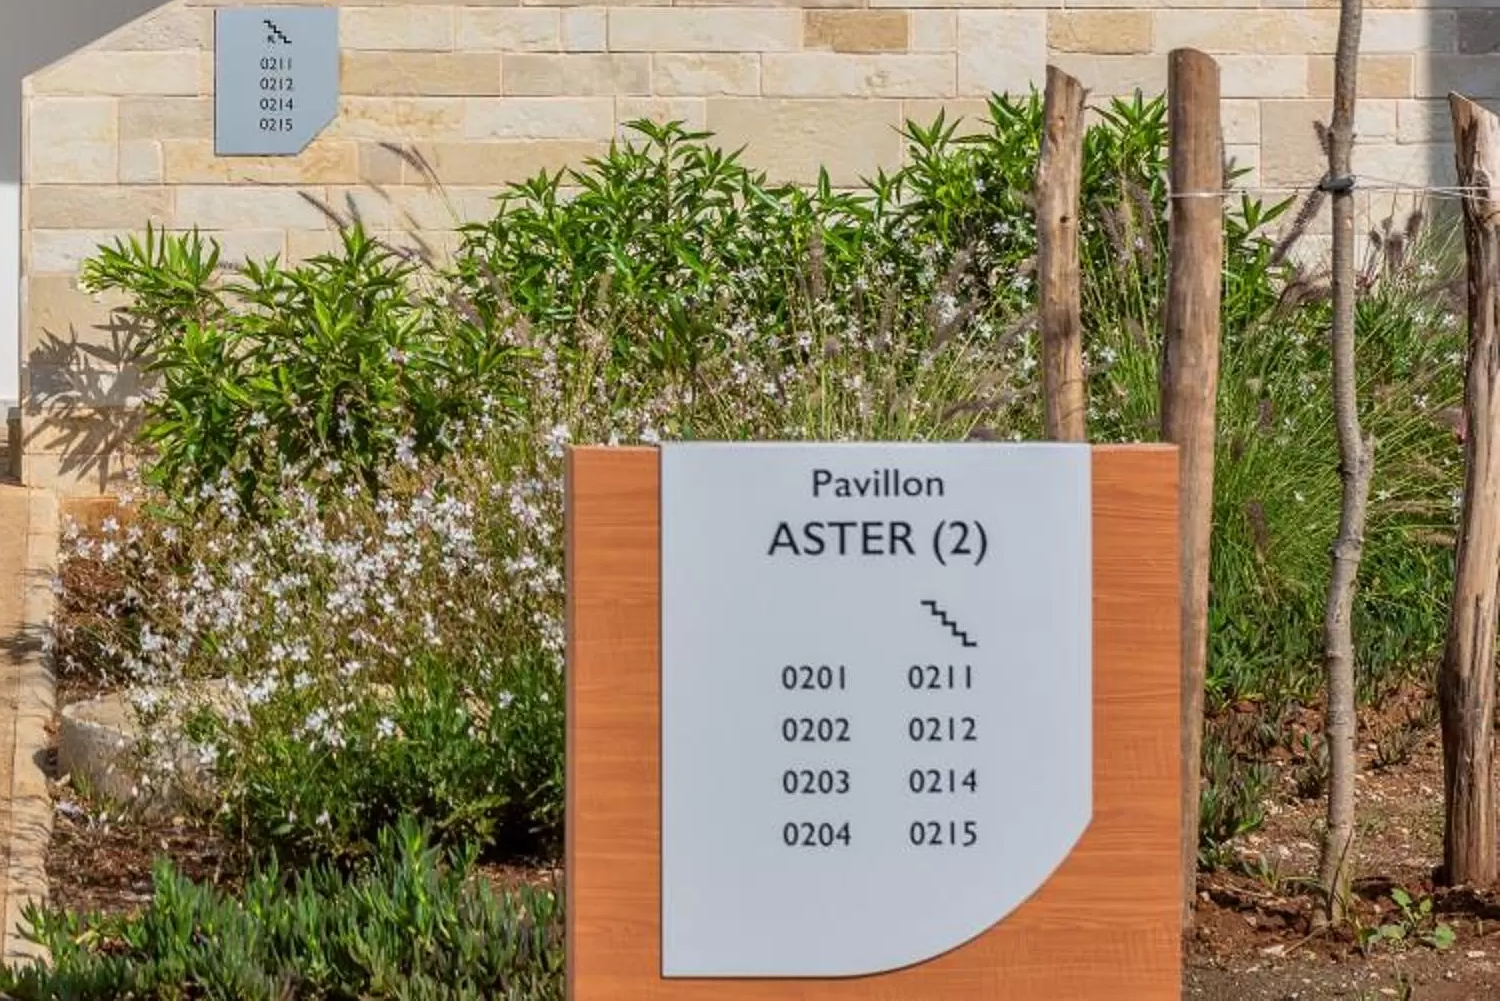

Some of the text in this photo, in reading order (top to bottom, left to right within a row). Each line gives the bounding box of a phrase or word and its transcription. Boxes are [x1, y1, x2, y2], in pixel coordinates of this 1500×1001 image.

[259, 57, 292, 71] 0211
[259, 77, 293, 91] 0212
[259, 97, 293, 111] 0214
[259, 117, 293, 132] 0215
[811, 468, 945, 498] Pavillon
[767, 520, 988, 566] ASTER (2)
[781, 665, 846, 691] 0201
[908, 665, 972, 691] 0211
[781, 717, 852, 743] 0202
[908, 717, 978, 743] 0212
[781, 769, 852, 795] 0203
[908, 769, 978, 795] 0214
[781, 821, 852, 847] 0204
[908, 821, 978, 847] 0215
